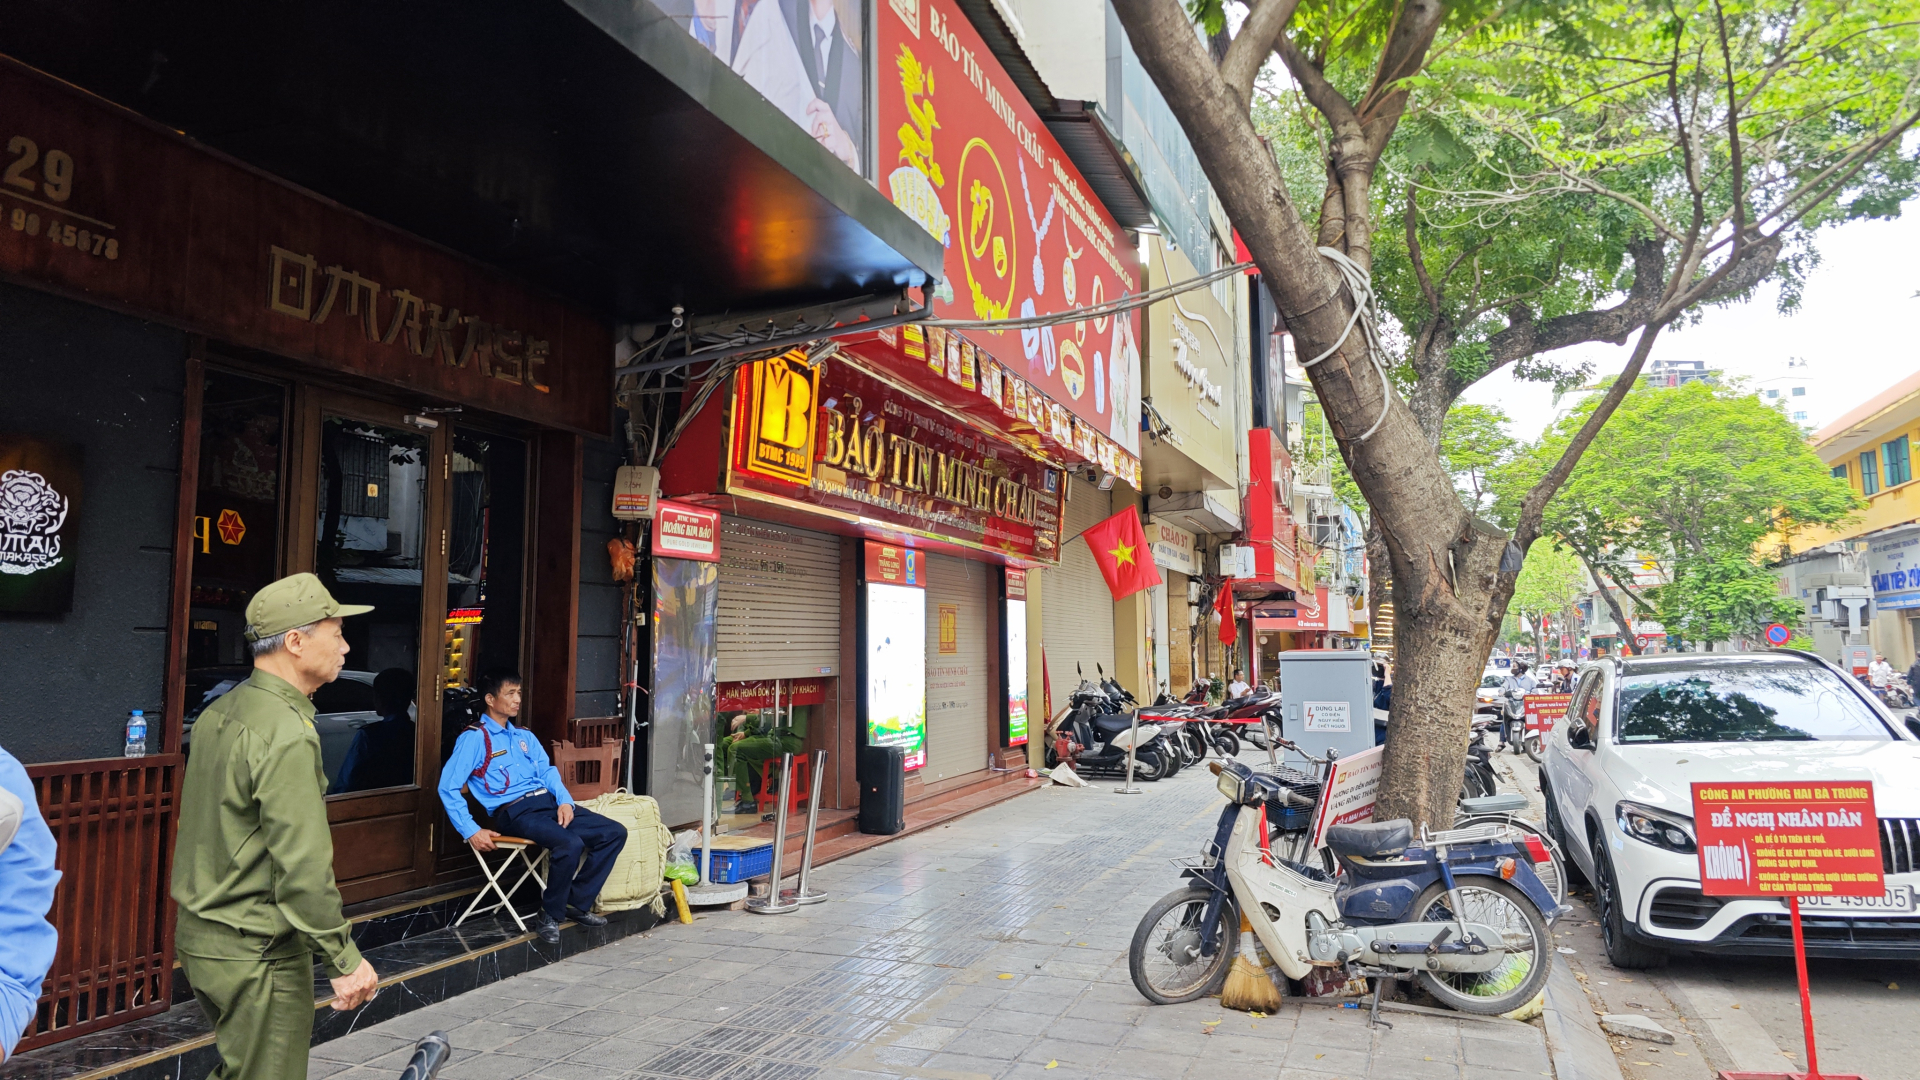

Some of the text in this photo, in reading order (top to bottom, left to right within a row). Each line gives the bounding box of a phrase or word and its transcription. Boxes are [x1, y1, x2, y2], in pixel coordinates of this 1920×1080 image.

[930, 4, 960, 62] BẢO
[961, 46, 983, 94] TÍN
[985, 77, 1016, 135] MINH
[4, 135, 74, 202] 29
[47, 220, 119, 260] 45678
[268, 245, 549, 393] OMAKASE
[758, 443, 805, 469] BTMC 1989
[824, 397, 884, 477] BẢO
[889, 427, 934, 495] TÍN
[937, 451, 993, 513] MINH
[994, 473, 1039, 527] CHÂU
[1048, 473, 1056, 489] 29
[663, 520, 711, 539] HOÀNG KIM BẢO
[1181, 534, 1188, 549] 37
[0, 533, 61, 557] MAIS
[678, 540, 690, 548] GOLD
[1700, 786, 1868, 800] CÔNG AN PHƯỜNG HAI BÀ TRƯNG
[1711, 806, 1862, 831] ĐỀ NGHỊ NHÂN DÂN
[1703, 839, 1744, 880] KHÔNG
[1756, 847, 1776, 857] KHÔNG
[1807, 848, 1822, 857] TRÊN
[1778, 859, 1788, 867] SAI
